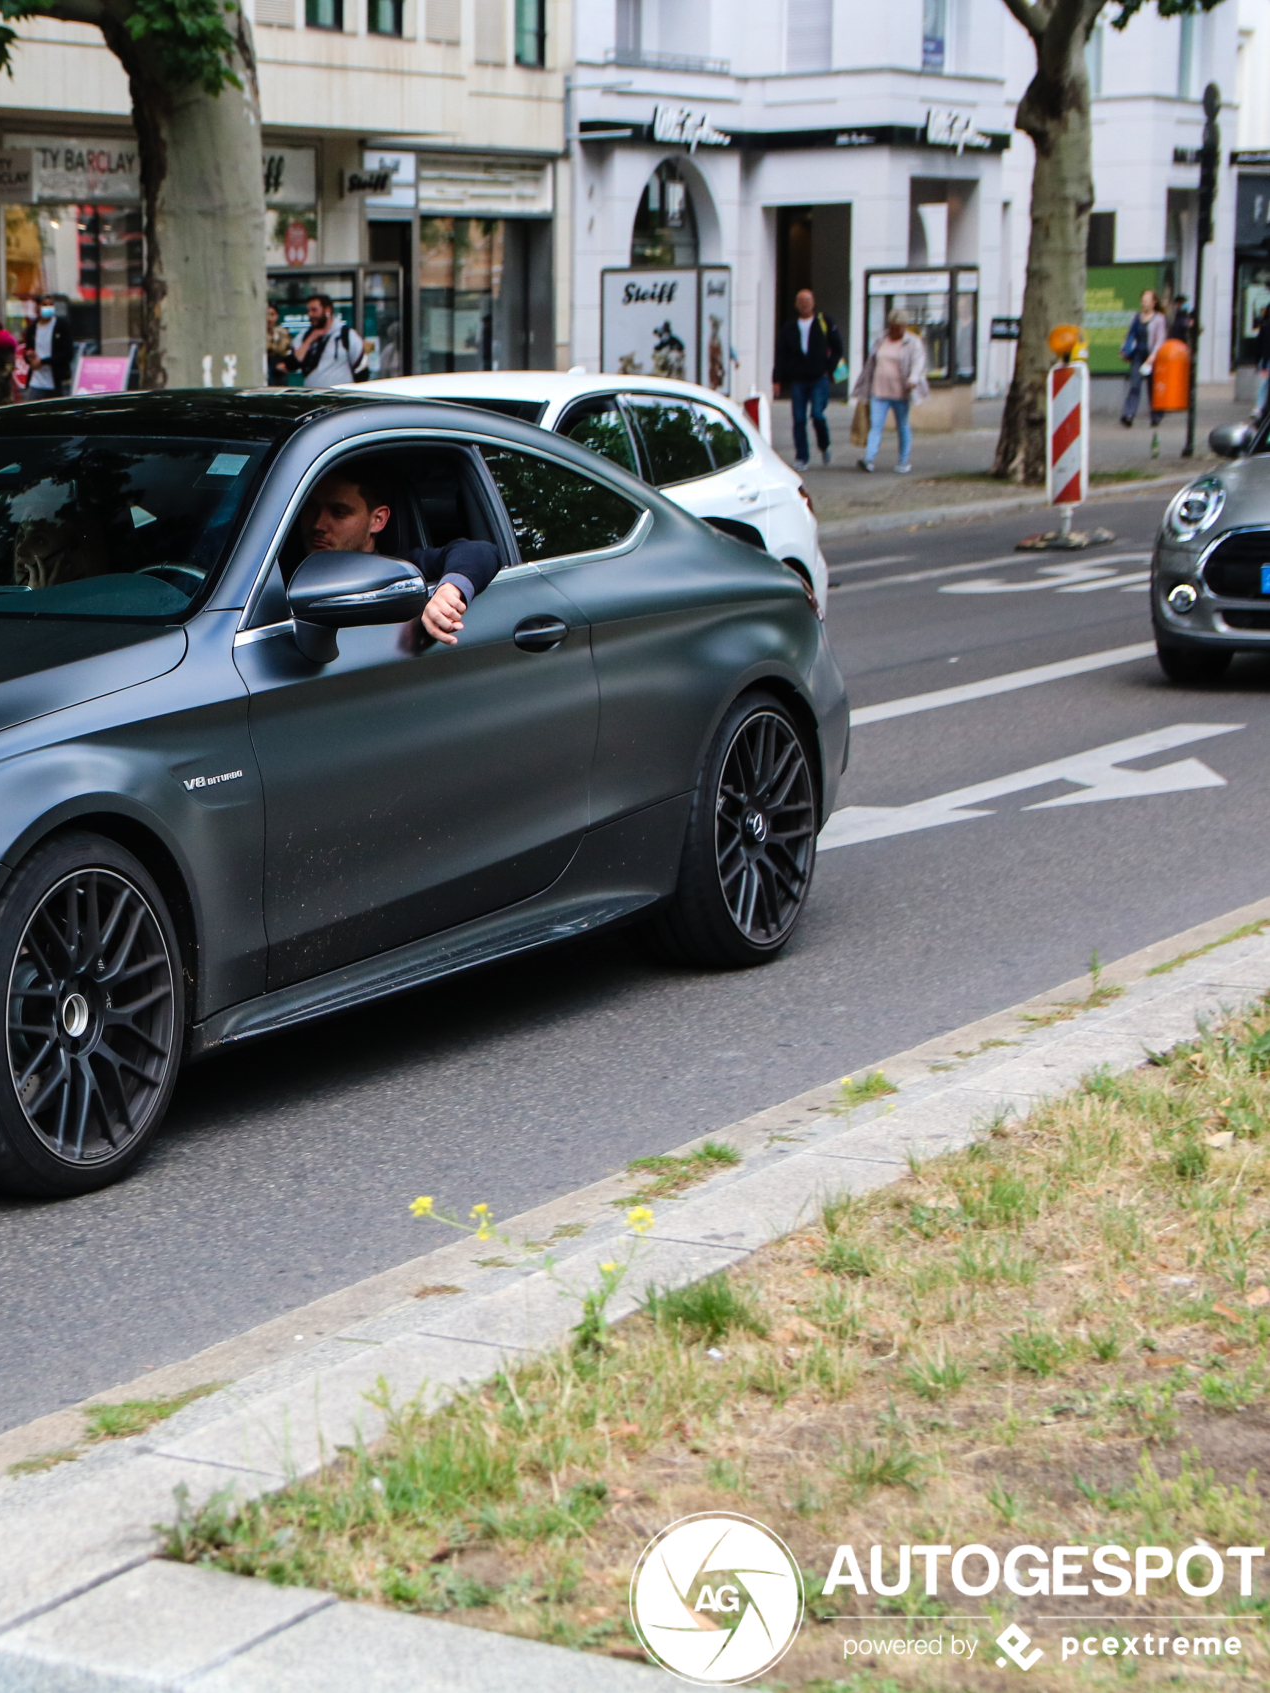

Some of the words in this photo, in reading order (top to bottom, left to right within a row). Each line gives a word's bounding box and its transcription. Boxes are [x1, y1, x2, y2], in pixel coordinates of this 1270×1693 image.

[622, 280, 678, 305] Steiff
[183, 776, 206, 791] V8
[207, 769, 243, 785] BITURBO
